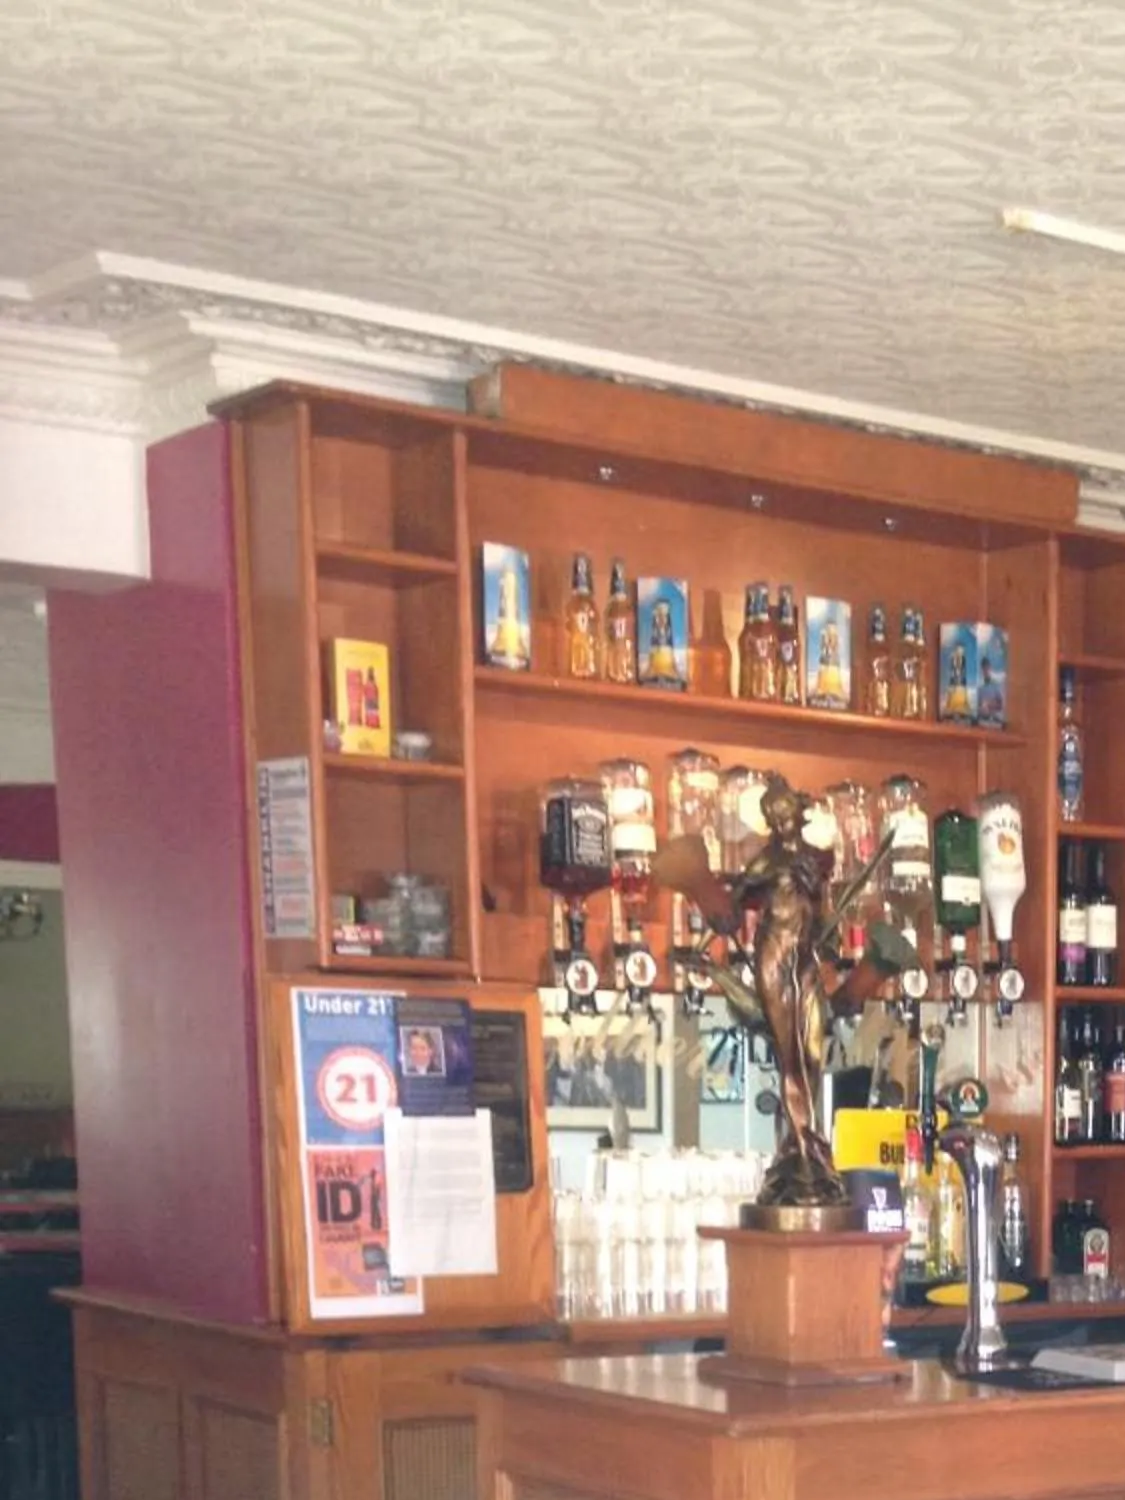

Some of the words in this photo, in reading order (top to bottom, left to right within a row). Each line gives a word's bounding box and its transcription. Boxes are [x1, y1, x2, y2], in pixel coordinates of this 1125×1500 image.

[304, 996, 361, 1014] Under
[336, 1074, 377, 1103] 21
[317, 1181, 362, 1223] ID
